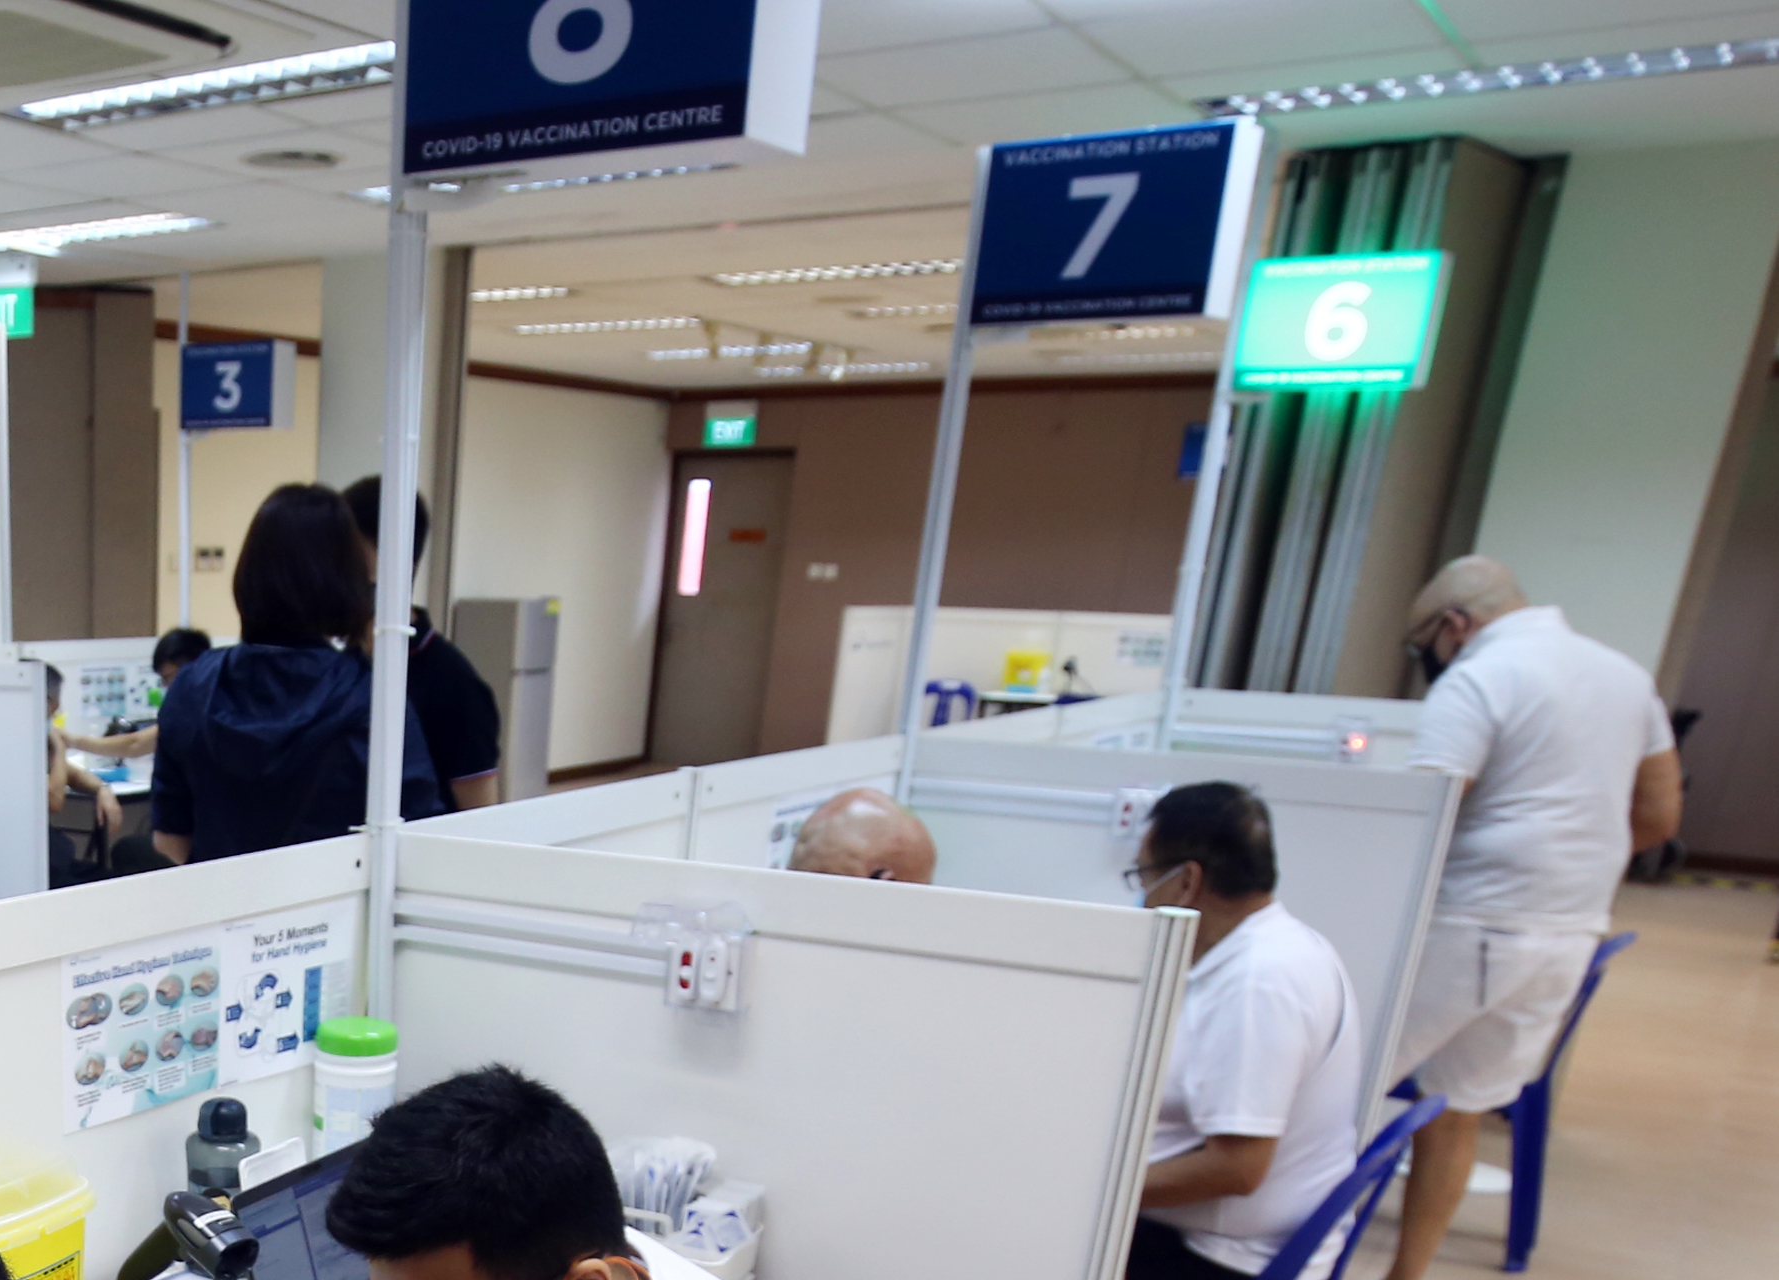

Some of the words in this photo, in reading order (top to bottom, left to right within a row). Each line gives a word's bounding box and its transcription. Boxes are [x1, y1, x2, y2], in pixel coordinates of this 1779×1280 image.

[422, 131, 504, 160] COVID-19
[507, 115, 639, 148] VACCINATION
[643, 104, 724, 131] CENTRE
[1003, 139, 1131, 167] VACCINATION
[1134, 130, 1220, 155] STATION
[1059, 172, 1141, 279] 7
[1304, 281, 1372, 362] 6
[213, 360, 241, 412] 3
[711, 419, 747, 441] EXIT
[253, 932, 275, 947] Your
[286, 922, 328, 940] Moments
